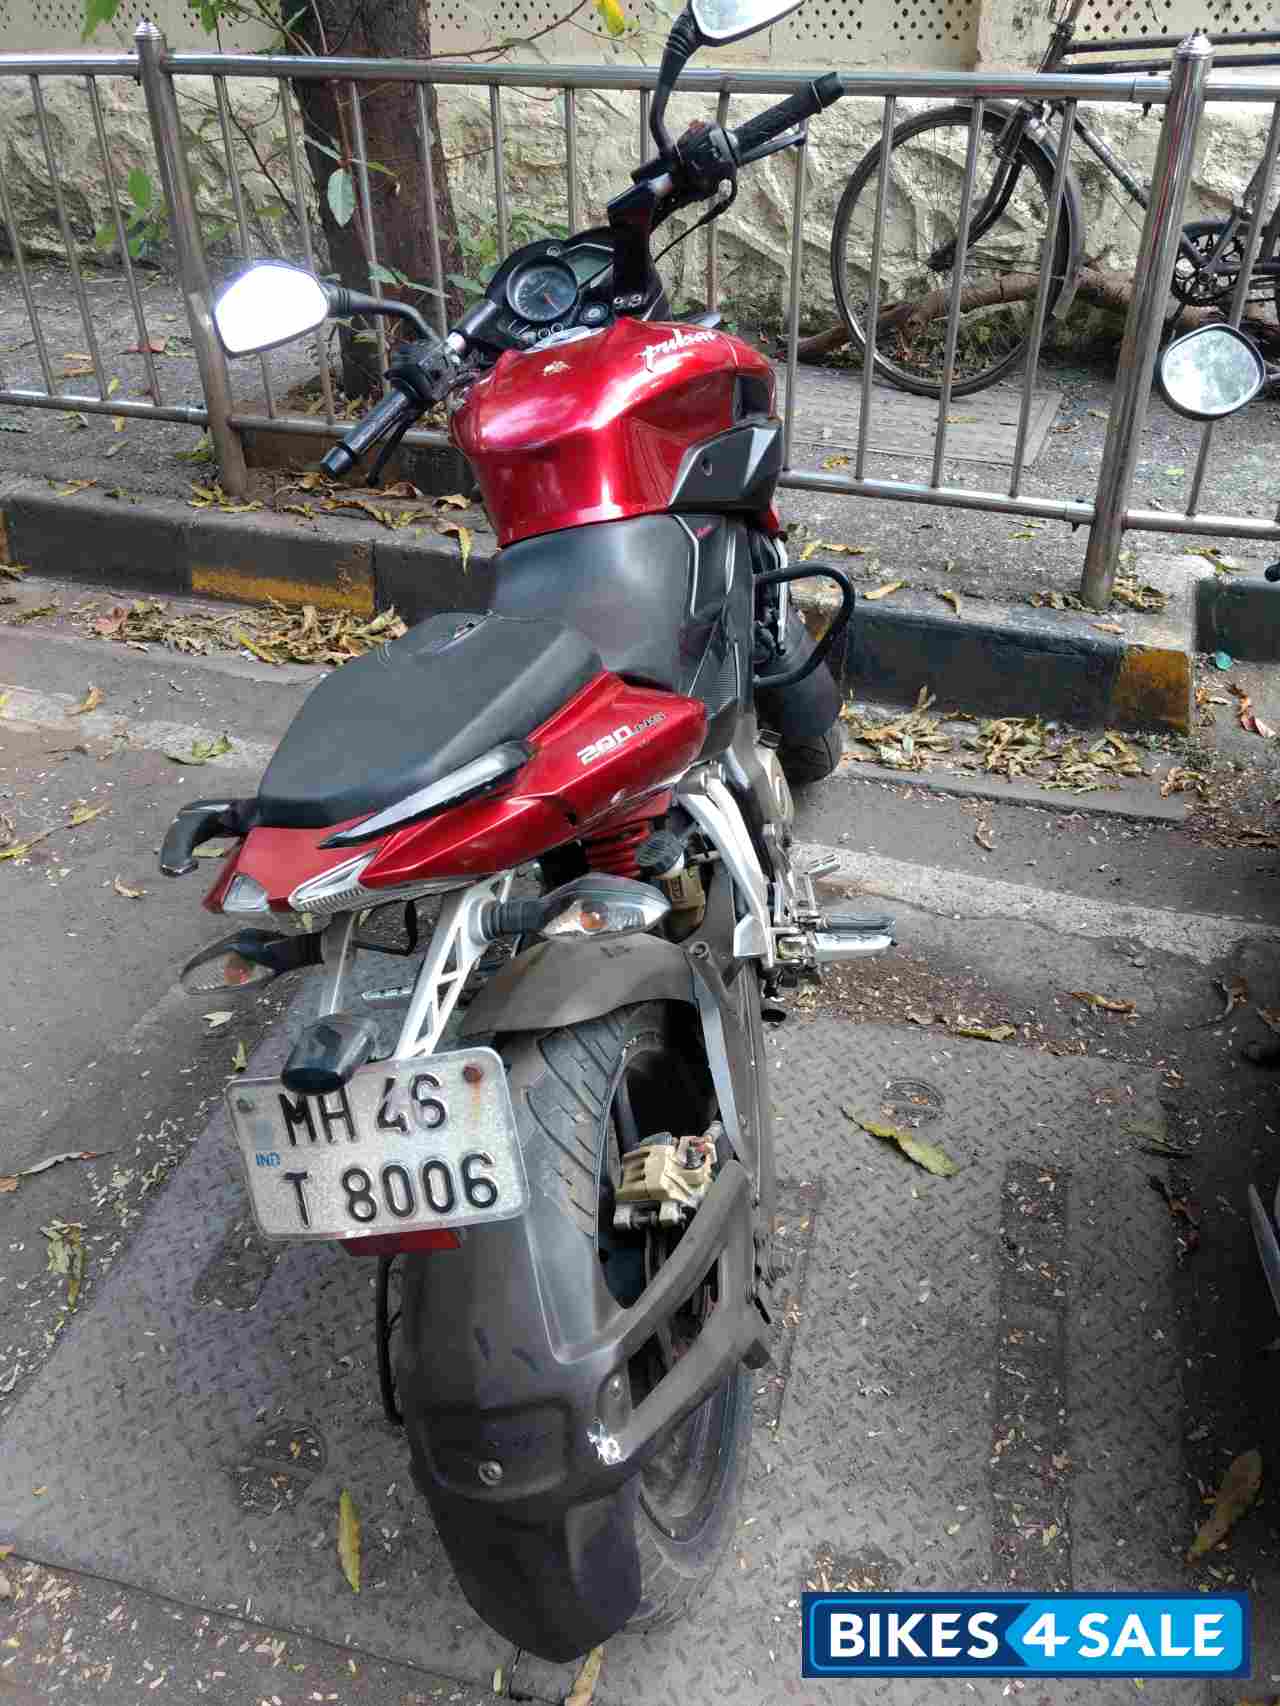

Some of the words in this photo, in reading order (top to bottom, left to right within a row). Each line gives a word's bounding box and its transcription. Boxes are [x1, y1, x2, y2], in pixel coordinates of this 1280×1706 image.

[278, 1089, 356, 1146] MH
[376, 1073, 447, 1134] 46
[284, 1171, 310, 1230] T
[342, 1151, 498, 1223] 8006
